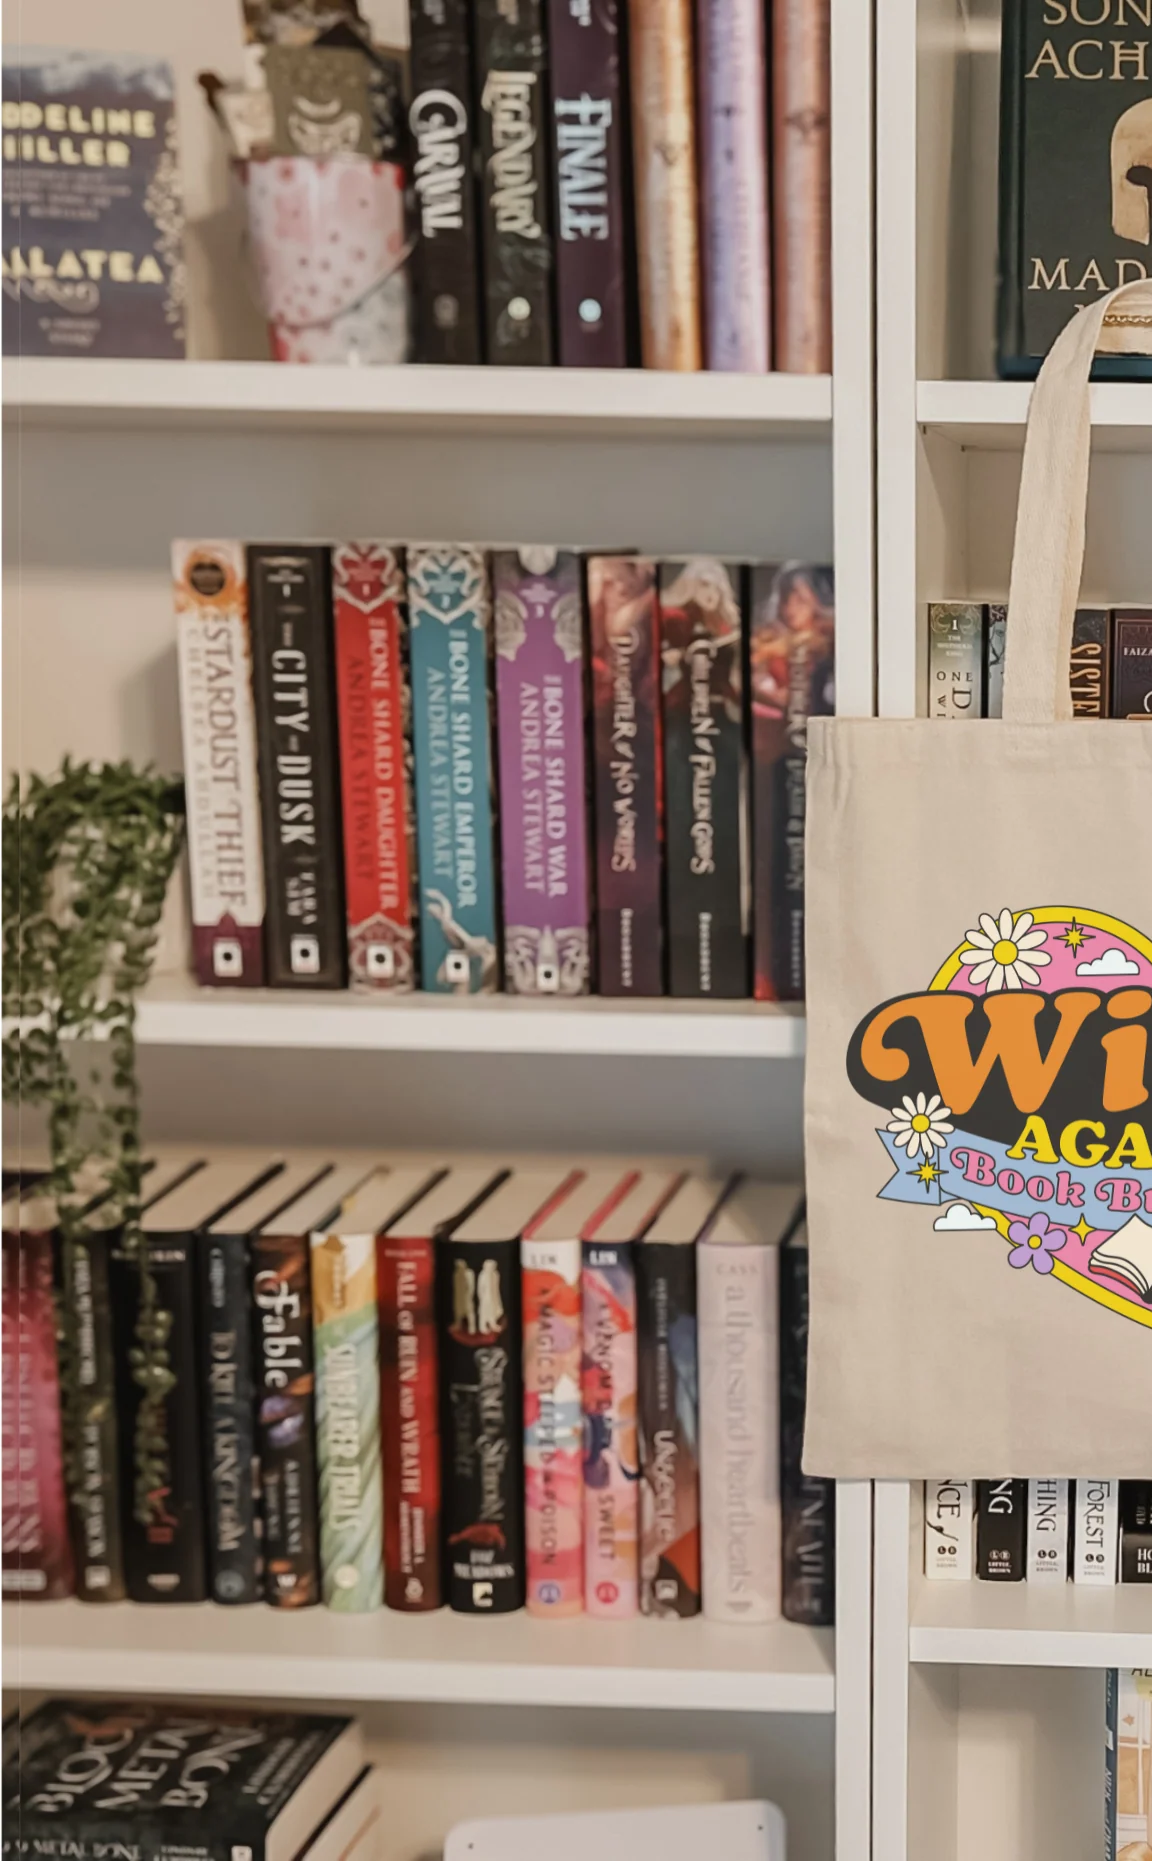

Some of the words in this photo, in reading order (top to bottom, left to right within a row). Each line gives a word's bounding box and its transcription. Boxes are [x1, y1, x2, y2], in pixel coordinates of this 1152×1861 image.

[481, 69, 542, 240] LEGENDARY
[553, 92, 613, 241] FINALE
[367, 629, 391, 692] BONE
[952, 620, 958, 631] 1
[201, 621, 242, 791] STARDUST
[271, 649, 310, 734] CITY
[448, 640, 472, 705] BONE
[609, 628, 641, 745] DAUGHTER
[936, 671, 973, 682] ONE
[1070, 642, 1102, 718] SISTE
[371, 700, 394, 784] SHARD
[452, 711, 475, 797] SHARD
[519, 682, 542, 785] ANDREA
[543, 686, 566, 752] BONE
[276, 755, 316, 846] DUSK
[522, 788, 546, 895] STEWART
[545, 756, 568, 846] SHARD
[214, 806, 250, 909] THIEF
[374, 787, 400, 911] DAUGHTER
[454, 802, 479, 909] EMPEROR
[546, 848, 569, 899] WAR
[689, 821, 715, 875] GODS
[949, 1146, 1085, 1208] Book
[396, 1261, 419, 1308] FALL
[589, 1250, 618, 1265] LIN
[254, 1269, 303, 1389] Fable
[397, 1335, 420, 1384] RUIN
[537, 1302, 555, 1368] MAGIC
[322, 1342, 360, 1457] SUNBEARER
[723, 1308, 755, 1441] thousand
[212, 1432, 241, 1552] KINGDOM
[400, 1420, 422, 1494] WRATH
[598, 1494, 616, 1562] SWEET
[726, 1447, 757, 1594] heartbeats
[1085, 1480, 1111, 1548] FOREST
